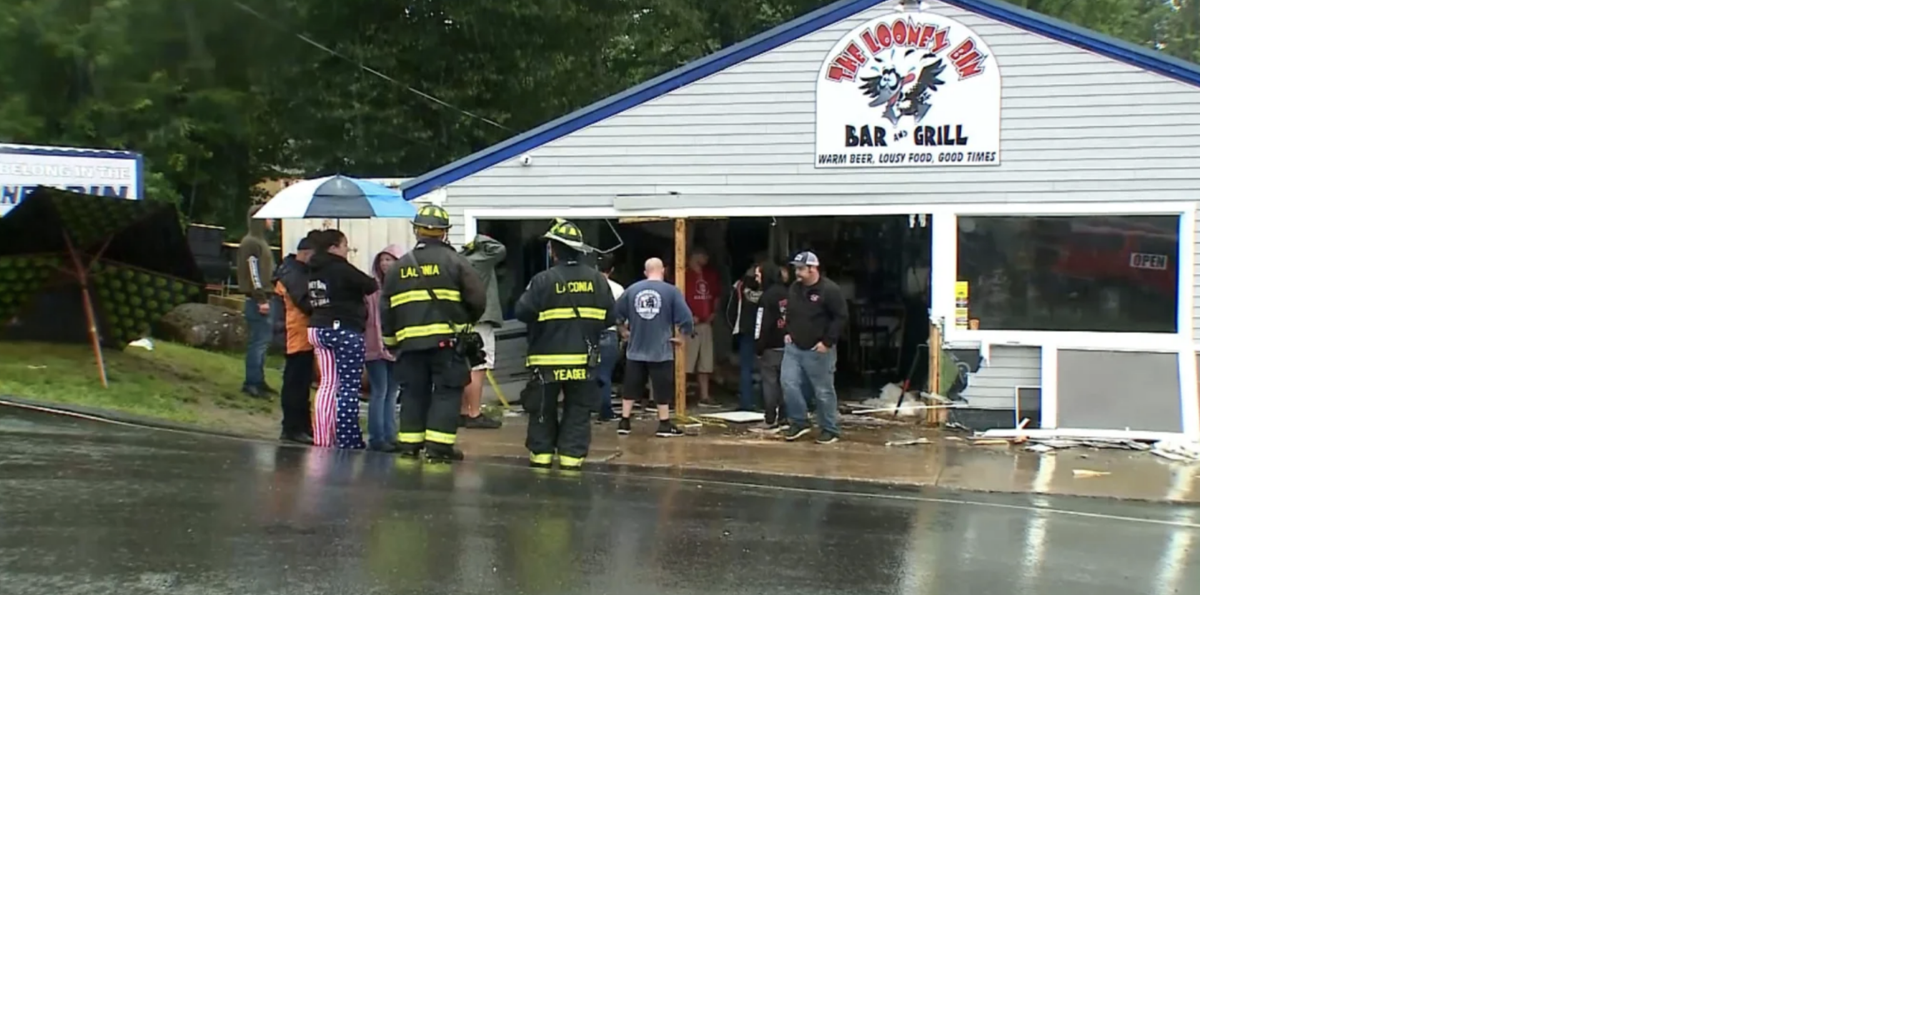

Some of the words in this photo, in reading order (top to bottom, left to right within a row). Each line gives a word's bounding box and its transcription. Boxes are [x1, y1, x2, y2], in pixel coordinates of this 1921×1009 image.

[826, 40, 868, 82] THE
[859, 16, 951, 55] LOONEY
[947, 37, 988, 82] BIN
[844, 125, 888, 147] BAR
[893, 130, 908, 142] AND
[913, 125, 968, 146] GRILL
[818, 154, 847, 164] WARM
[849, 154, 875, 164] BEER,
[878, 153, 906, 164] LOUSY
[908, 153, 934, 164] FOOD,
[938, 152, 963, 162] GOOD
[967, 151, 997, 162] TIMES
[75, 165, 94, 178] IN
[97, 166, 131, 179] THE
[1133, 254, 1165, 268] OPEN
[553, 368, 586, 380] YEAGER
